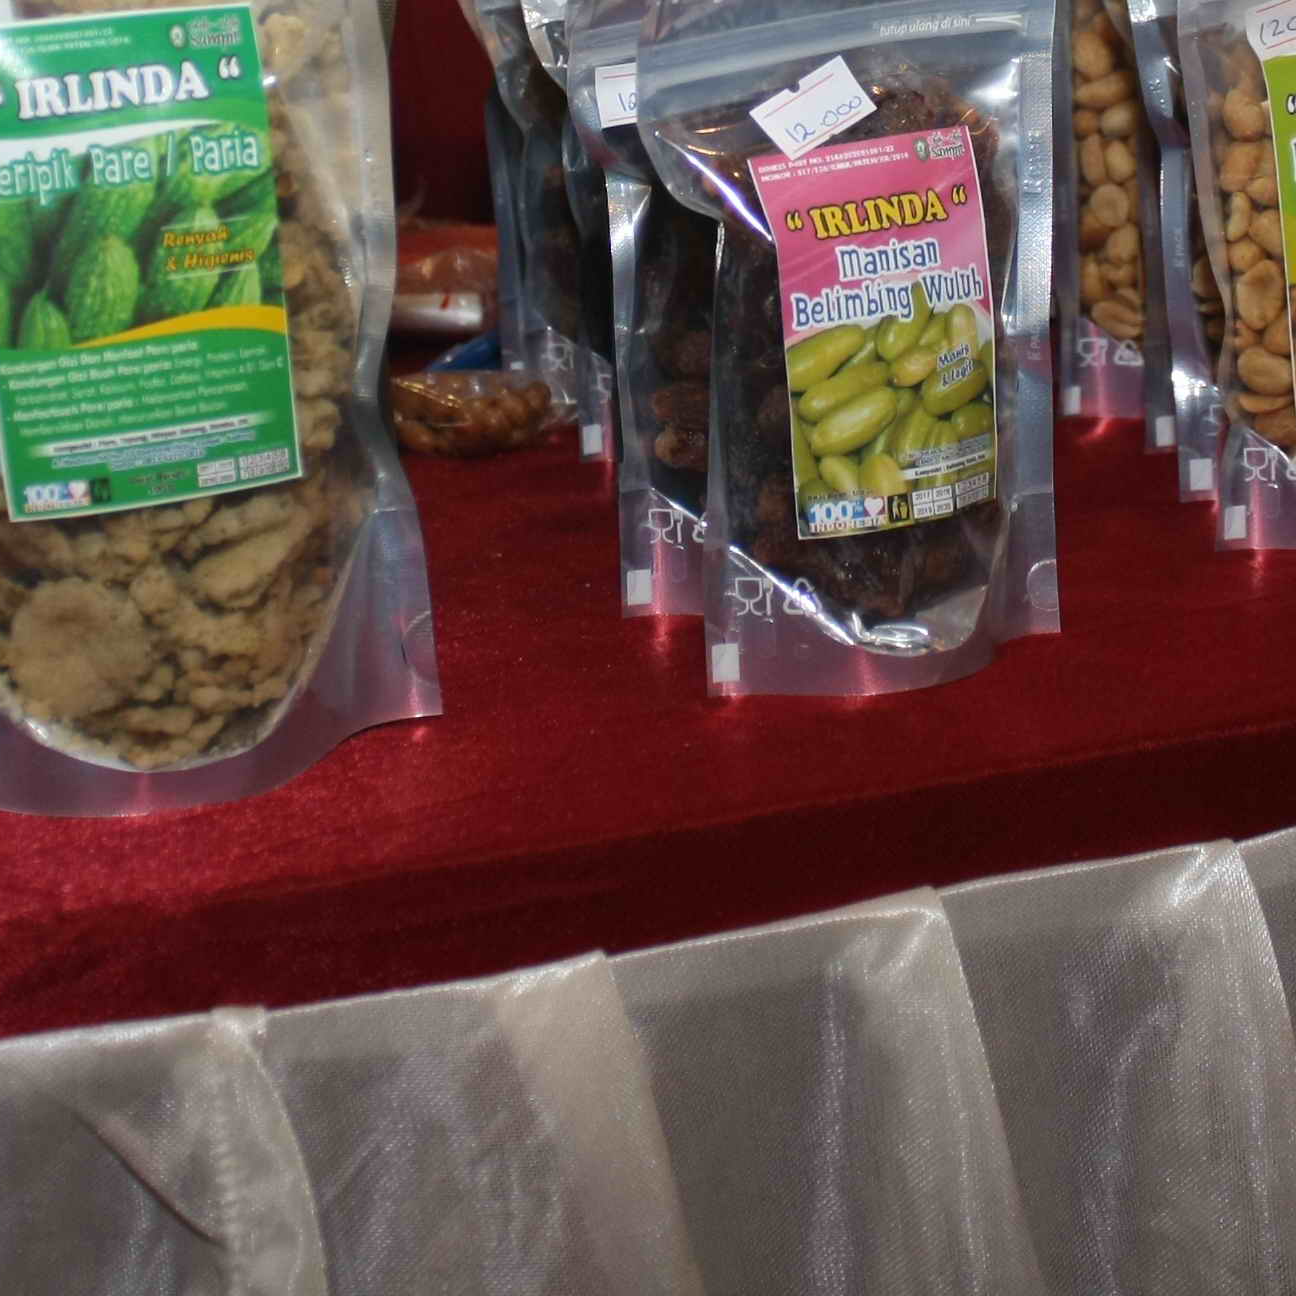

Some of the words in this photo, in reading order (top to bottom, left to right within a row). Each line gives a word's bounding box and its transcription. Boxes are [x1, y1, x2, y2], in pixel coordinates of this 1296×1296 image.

[15, 60, 209, 120] IRLINDA
[91, 138, 152, 185] Pare
[190, 132, 261, 173] Paria
[809, 187, 950, 241] IRLINDA
[793, 283, 913, 328] Belimbing
[921, 267, 984, 305] Wuluh
